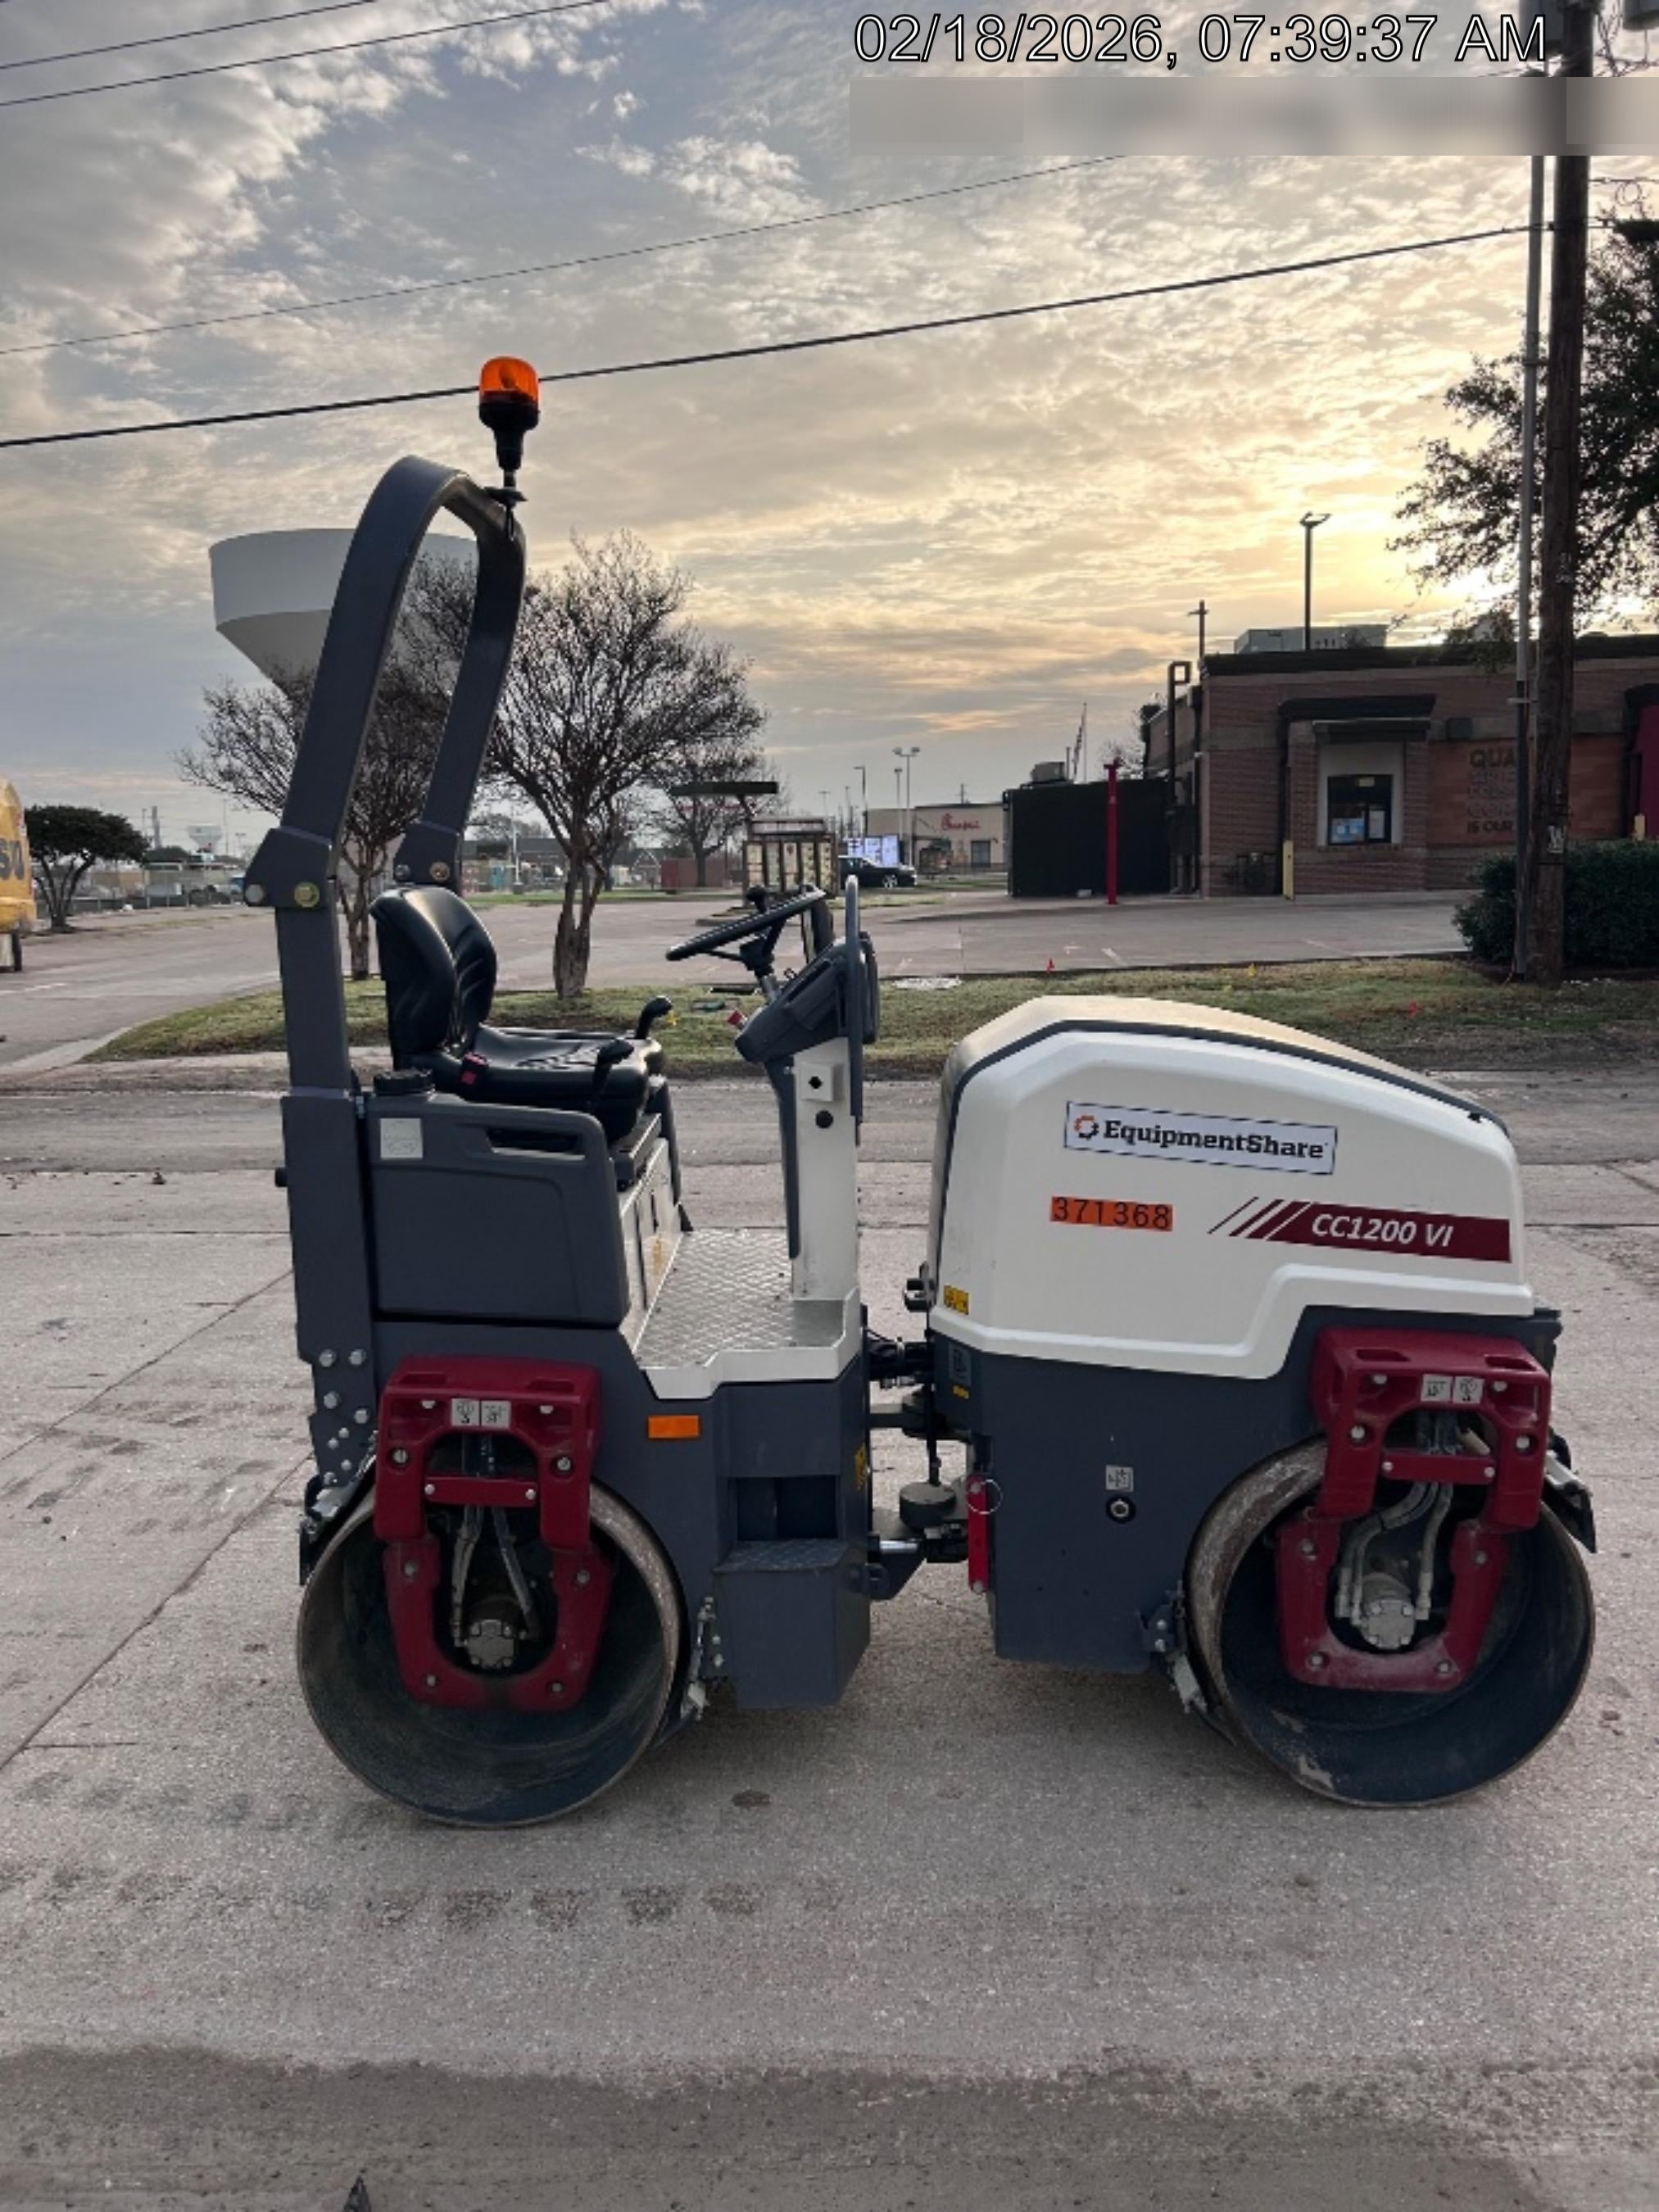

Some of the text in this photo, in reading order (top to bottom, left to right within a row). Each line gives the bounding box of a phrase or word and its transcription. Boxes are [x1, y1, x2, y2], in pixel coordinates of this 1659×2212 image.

[1103, 1120, 1325, 1158] EquipmentShare
[1052, 1196, 1171, 1229] 371368
[1312, 1213, 1454, 1248] CC1200 VI
